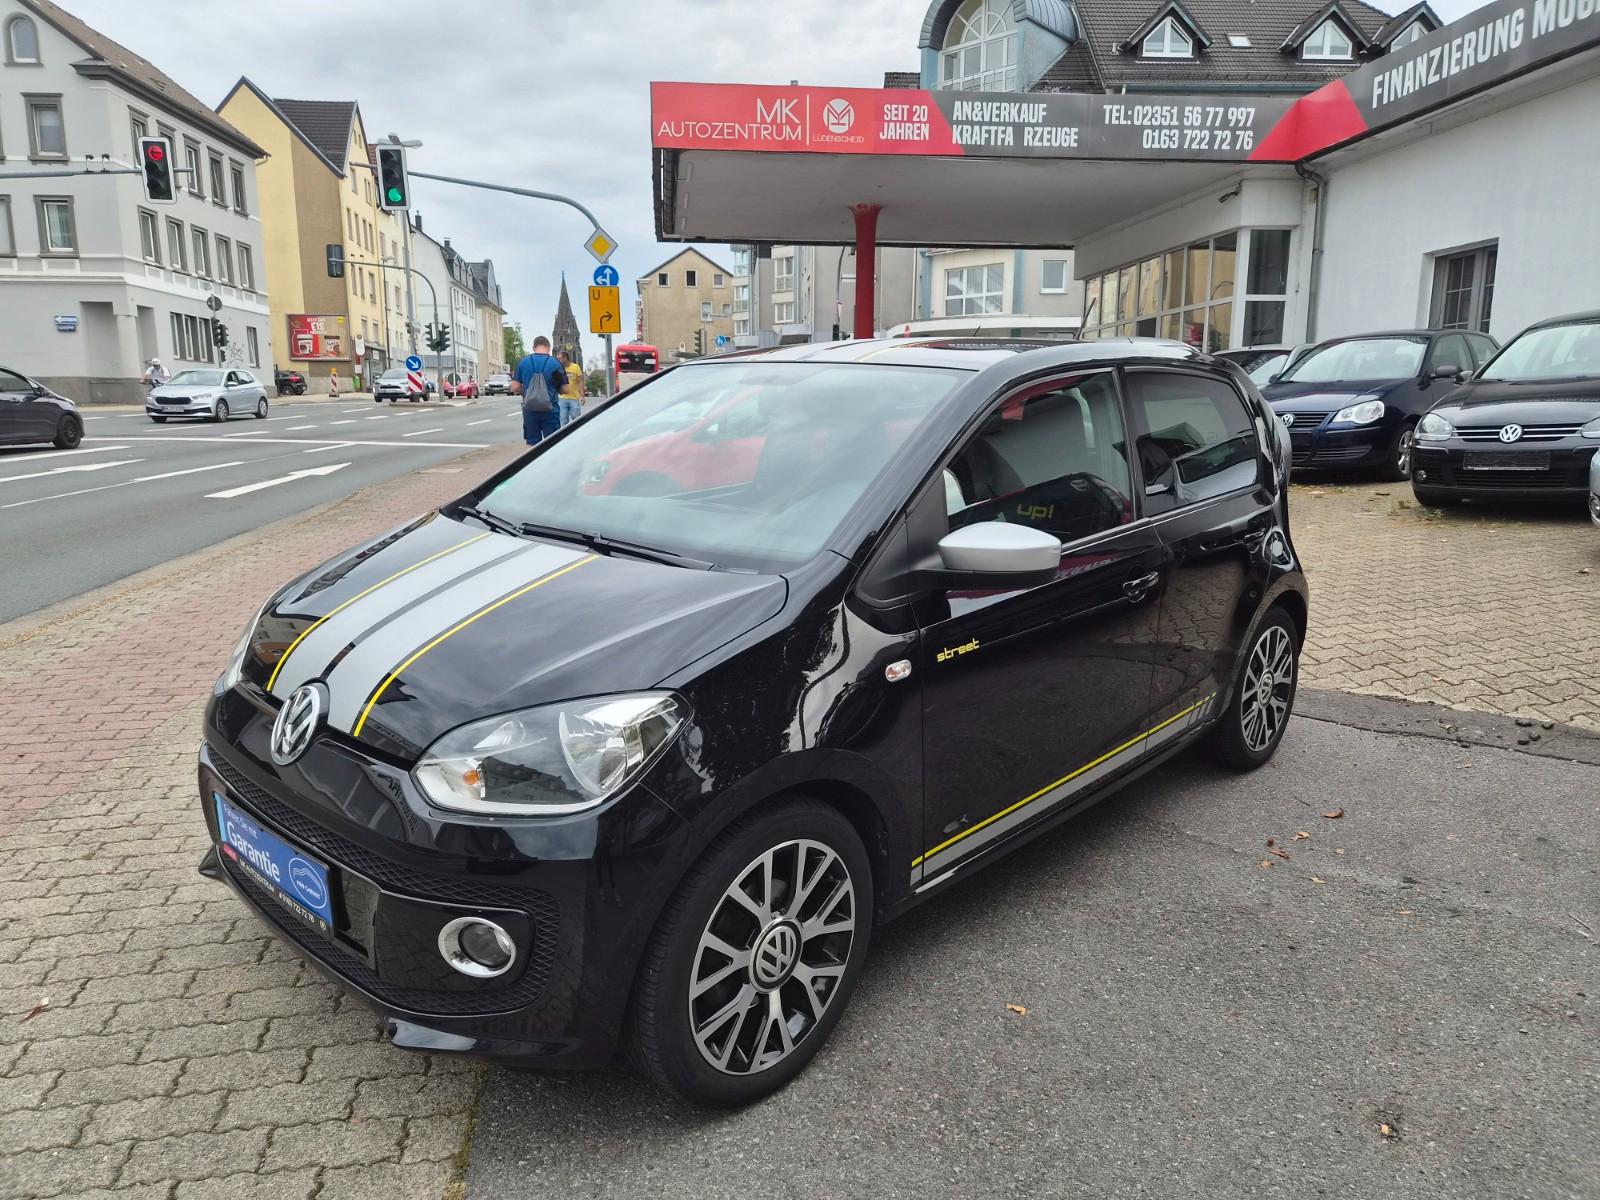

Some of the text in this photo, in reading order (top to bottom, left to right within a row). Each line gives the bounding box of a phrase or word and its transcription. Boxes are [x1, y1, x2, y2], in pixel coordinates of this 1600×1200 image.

[1372, 8, 1525, 109] FINANZIERUNG
[757, 98, 801, 124] MK
[884, 104, 928, 122] SEIT 20
[953, 101, 1047, 123] AN&VERKAUF
[1183, 106, 1202, 126] 56
[1206, 107, 1224, 127] 77
[1228, 107, 1256, 127] 997
[657, 121, 802, 141] AUTOZENTRUM
[880, 123, 929, 141] JAHREN
[1143, 129, 1254, 150] 0163 722 72 76
[1017, 503, 1055, 520] up!
[937, 638, 980, 663] street
[226, 821, 281, 883] Garantie
